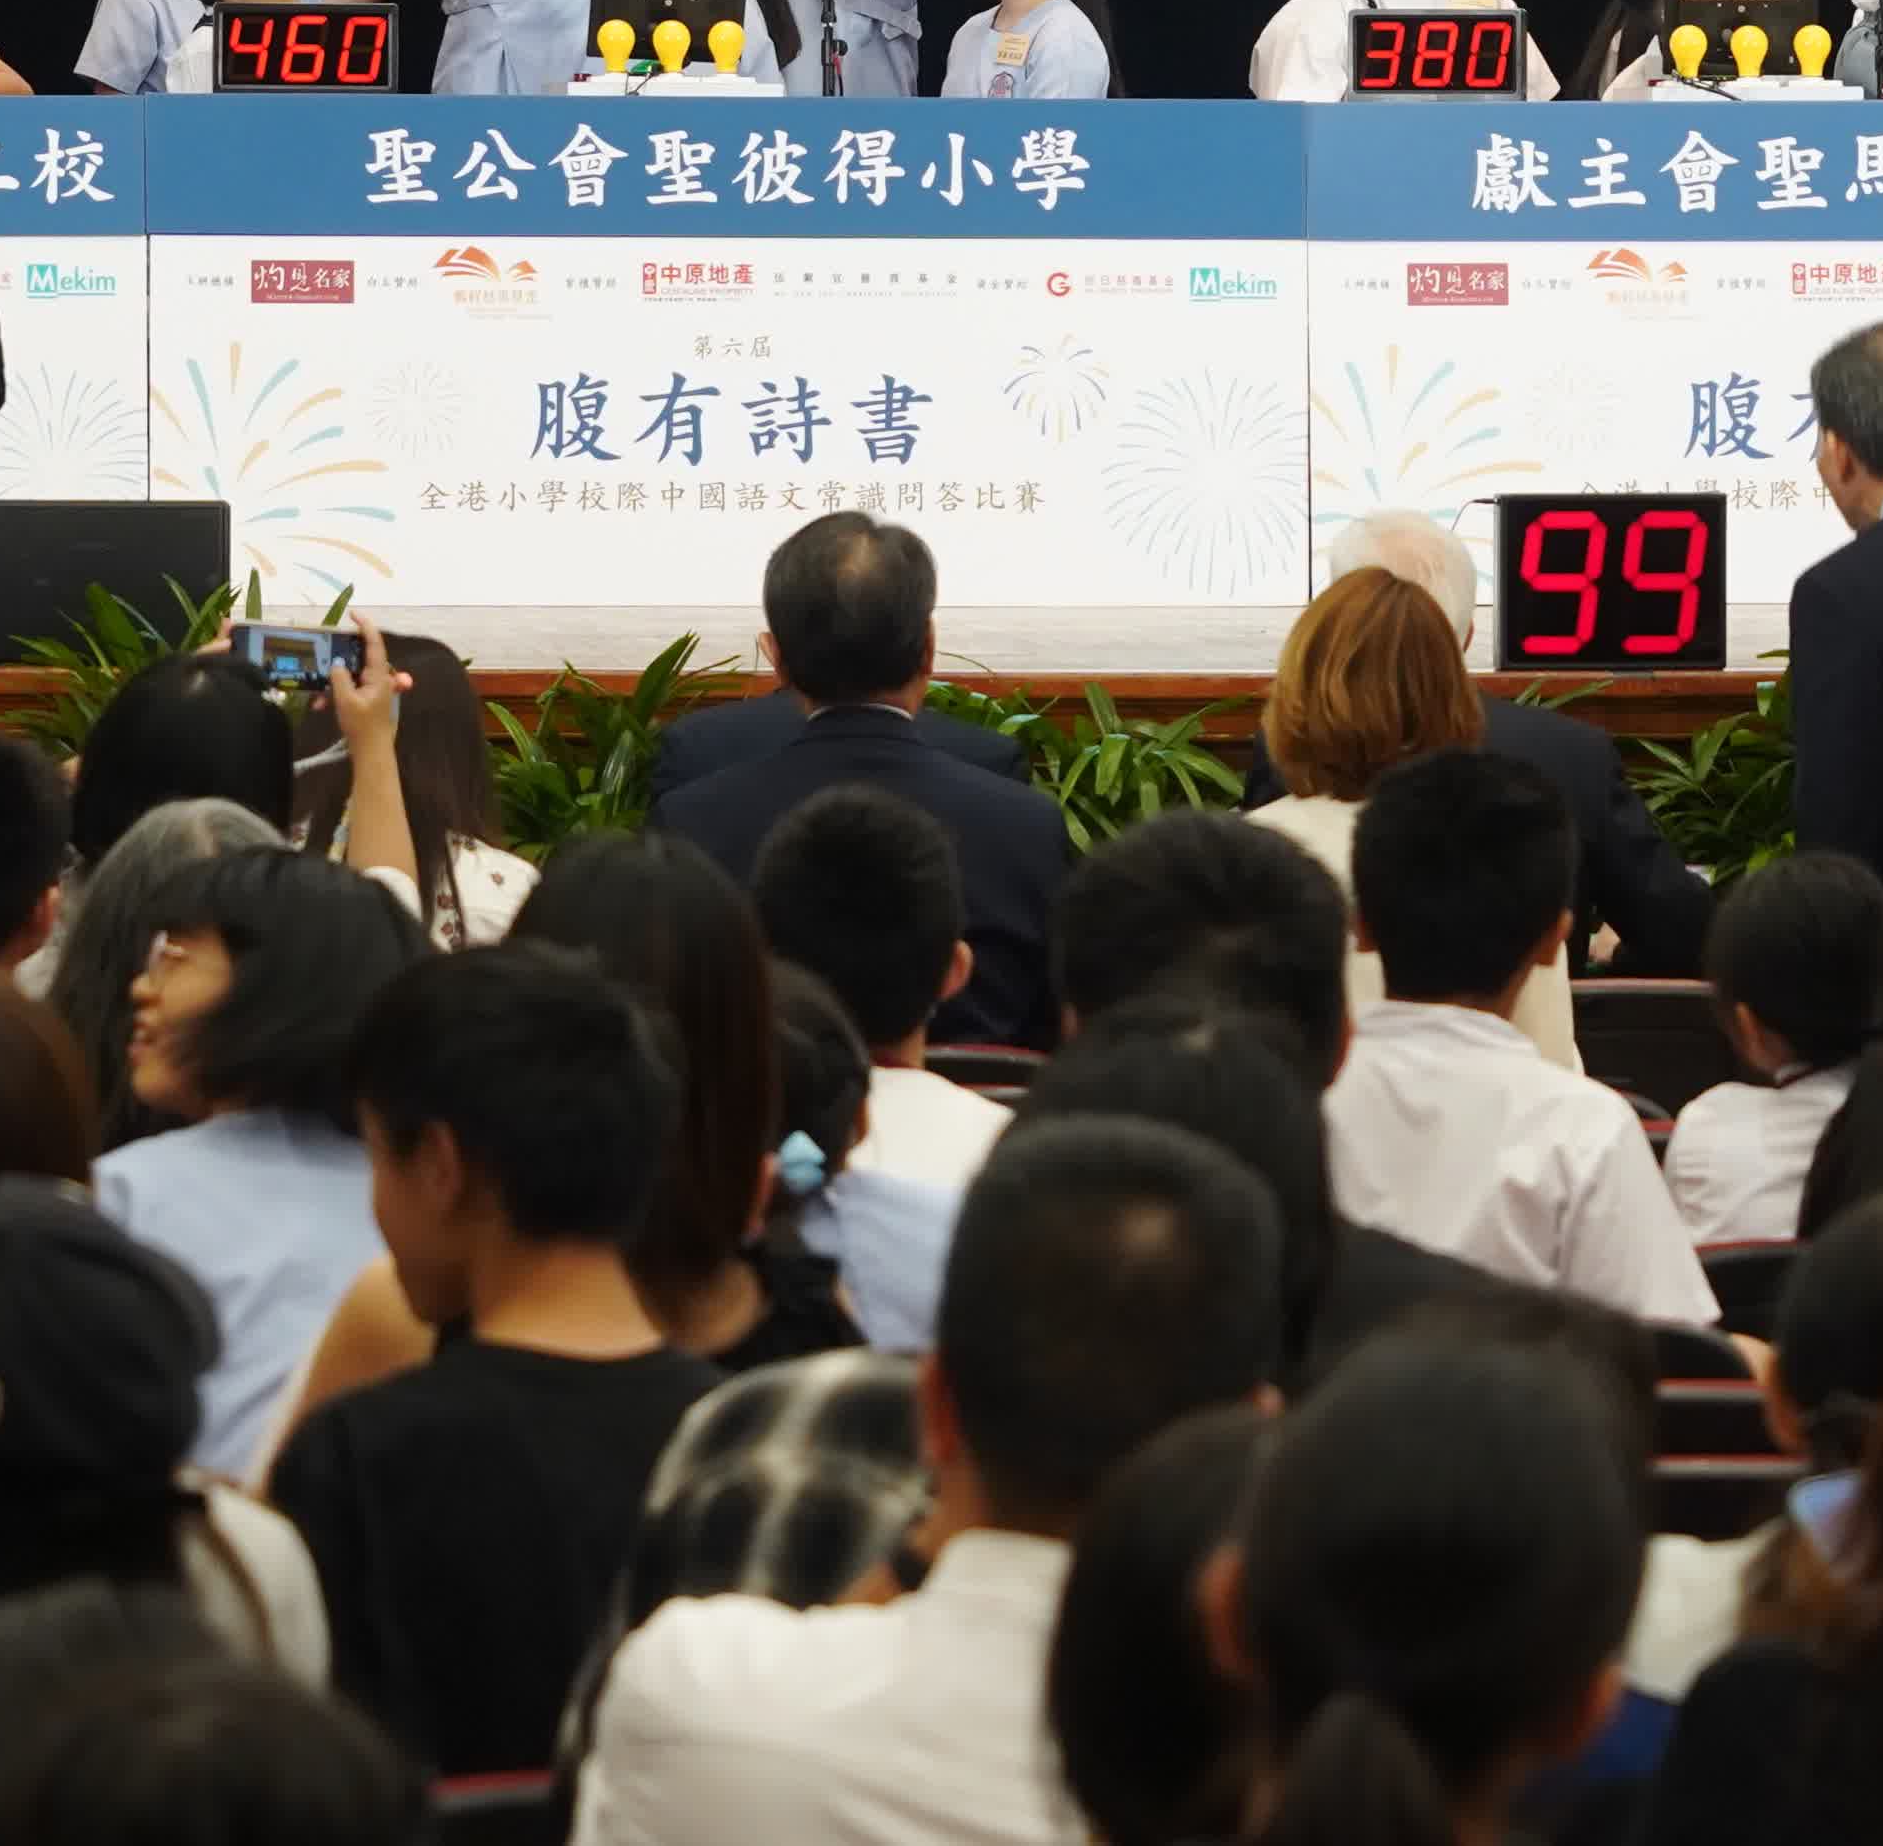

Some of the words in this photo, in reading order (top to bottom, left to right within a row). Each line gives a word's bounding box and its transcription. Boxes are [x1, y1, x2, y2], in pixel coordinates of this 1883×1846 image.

[229, 15, 384, 84] 460
[1362, 22, 1512, 90] 380
[364, 122, 1092, 211] 聖公會聖彼得小學
[26, 263, 117, 294] Mekim
[253, 262, 351, 293] 灼見名家
[660, 262, 756, 285] 中原地產
[1189, 266, 1277, 297] Mekim
[1409, 264, 1506, 295] 灼見名家
[693, 334, 774, 360] 第六屆
[531, 370, 935, 468] 腹有詩書
[416, 479, 1047, 514] 全港小學校際中國語文常識問答比賽
[1519, 510, 1709, 654] 99
